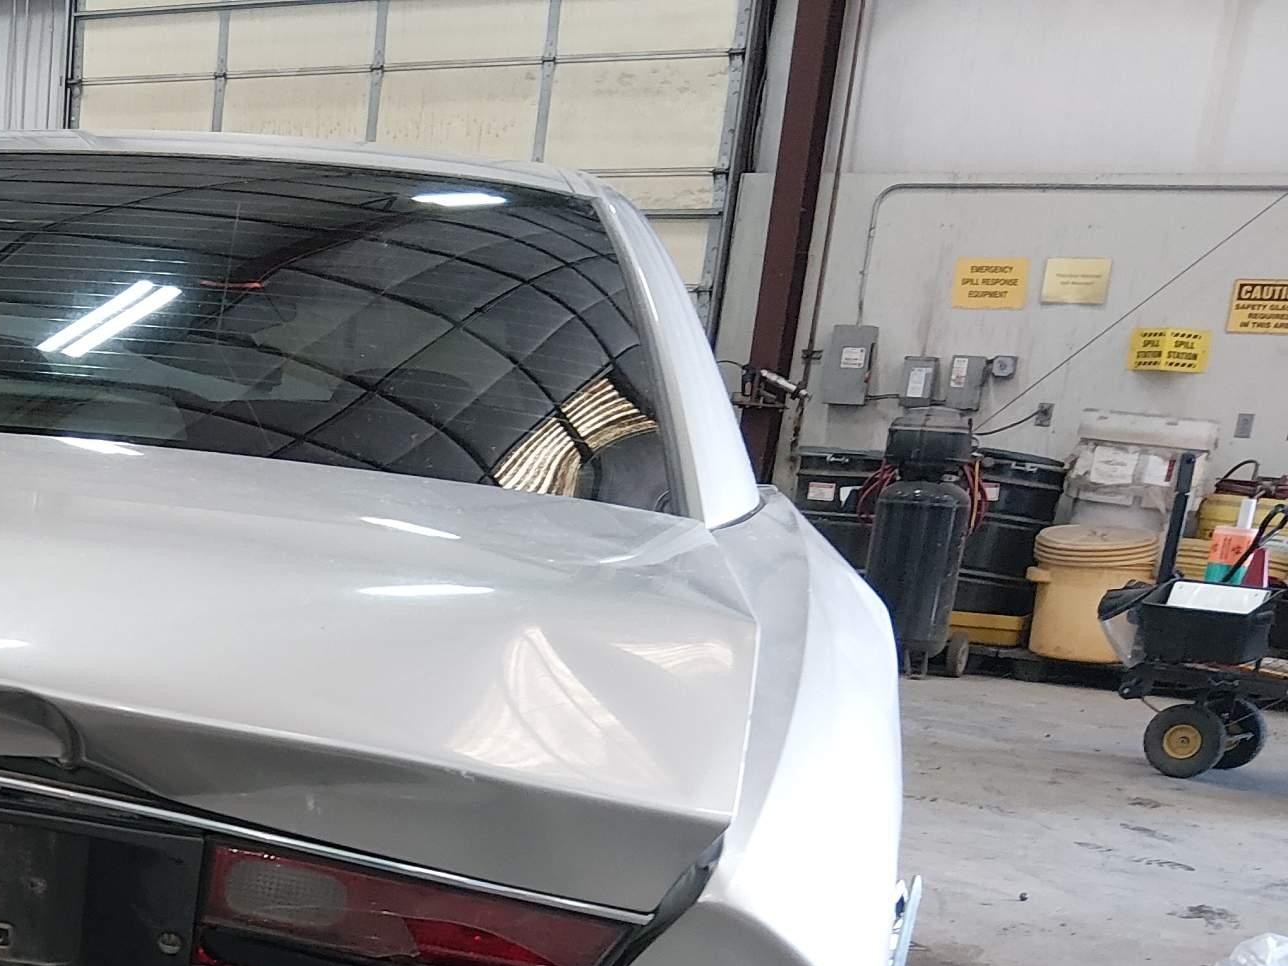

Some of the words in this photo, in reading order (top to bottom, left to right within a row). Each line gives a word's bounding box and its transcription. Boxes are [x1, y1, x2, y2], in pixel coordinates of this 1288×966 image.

[1240, 285, 1288, 300] CAUTI
[1234, 303, 1268, 311] SAFETY
[1174, 340, 1195, 350] SPILL
